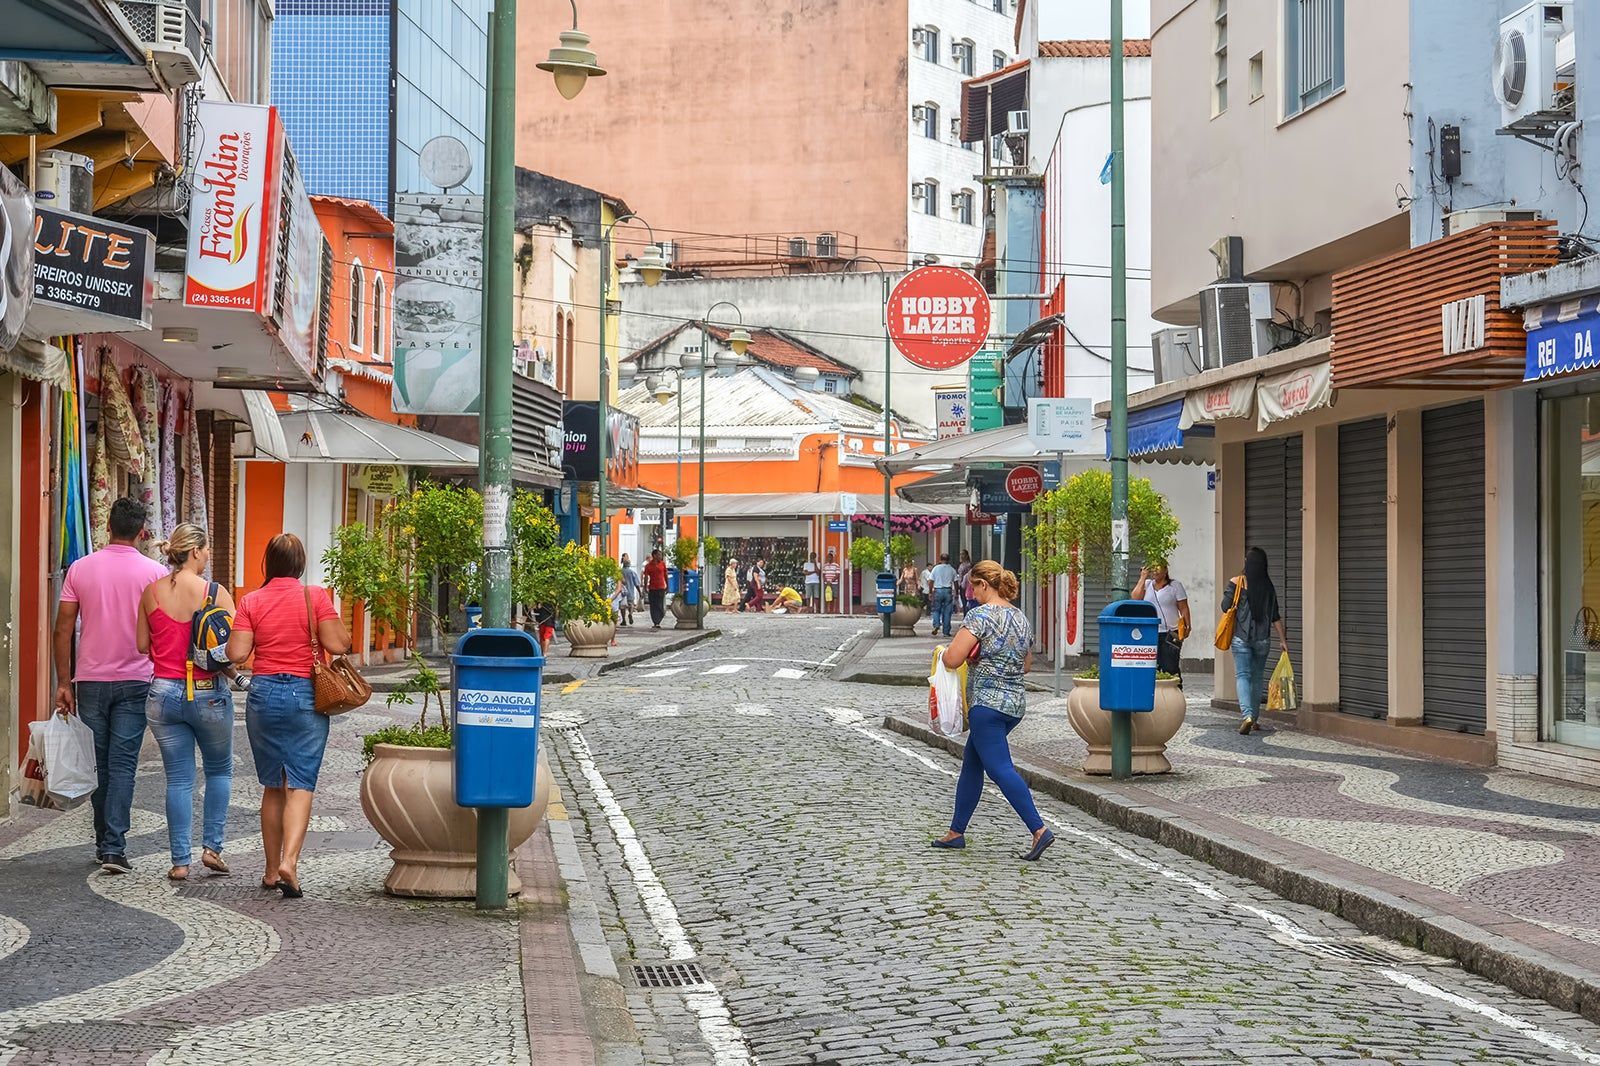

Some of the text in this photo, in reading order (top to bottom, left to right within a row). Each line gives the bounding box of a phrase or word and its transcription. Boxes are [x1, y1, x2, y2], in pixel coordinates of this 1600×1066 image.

[237, 131, 251, 181] Decorações
[199, 131, 240, 264] Franklin
[399, 196, 484, 205] PIZZA
[200, 207, 212, 234] Casas
[85, 275, 133, 298] UNISSEX
[47, 286, 100, 308] 3365-5779
[192, 293, 251, 305] (24) 3365-1114
[901, 296, 977, 315] HOBBY
[902, 316, 976, 334] LAZER
[1538, 330, 1593, 368] REI DA
[565, 442, 586, 452] biju
[1011, 476, 1039, 485] HOBBY
[1012, 483, 1039, 492] LAZER
